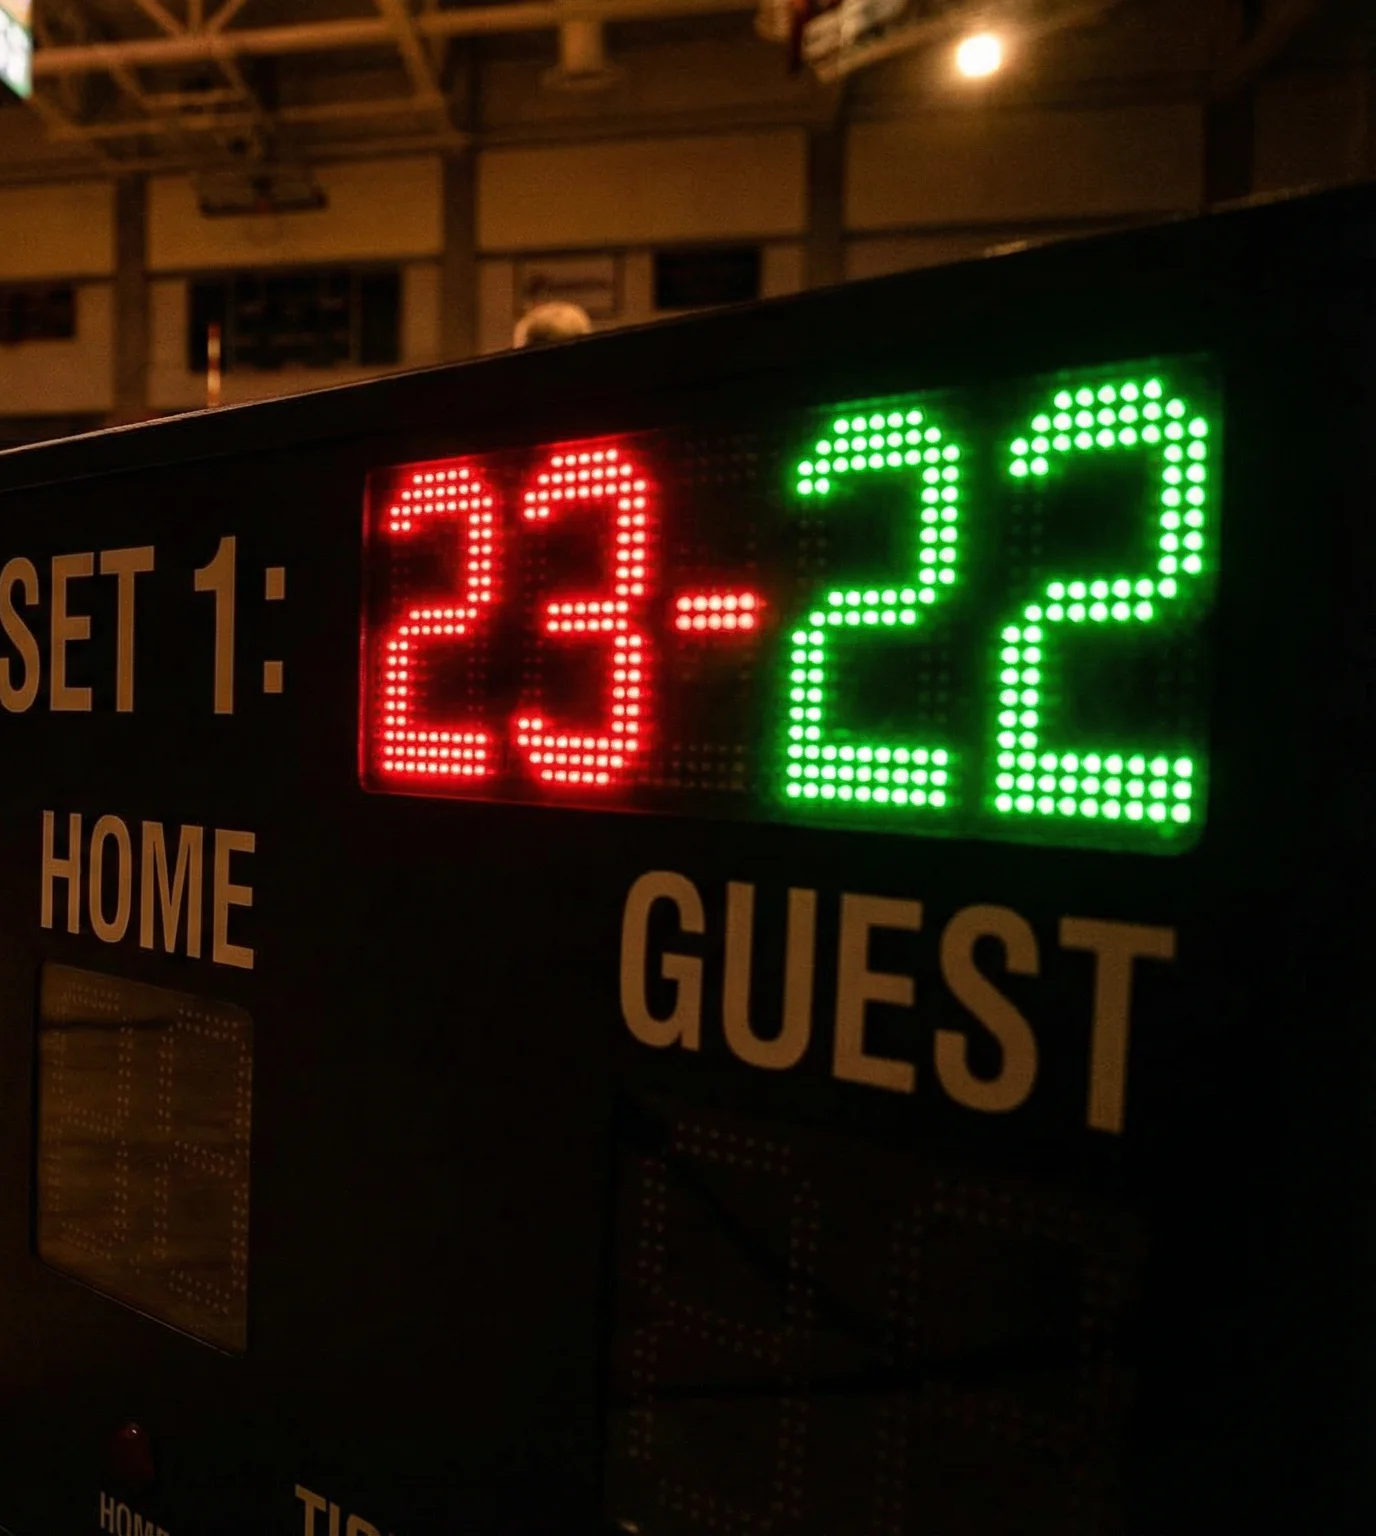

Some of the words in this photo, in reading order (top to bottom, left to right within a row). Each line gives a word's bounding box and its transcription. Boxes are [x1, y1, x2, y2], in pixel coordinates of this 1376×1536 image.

[194, 535, 286, 715] 1:
[381, 378, 1209, 824] 23-22
[40, 810, 256, 970] HOME
[619, 869, 1178, 1136] GUEST
